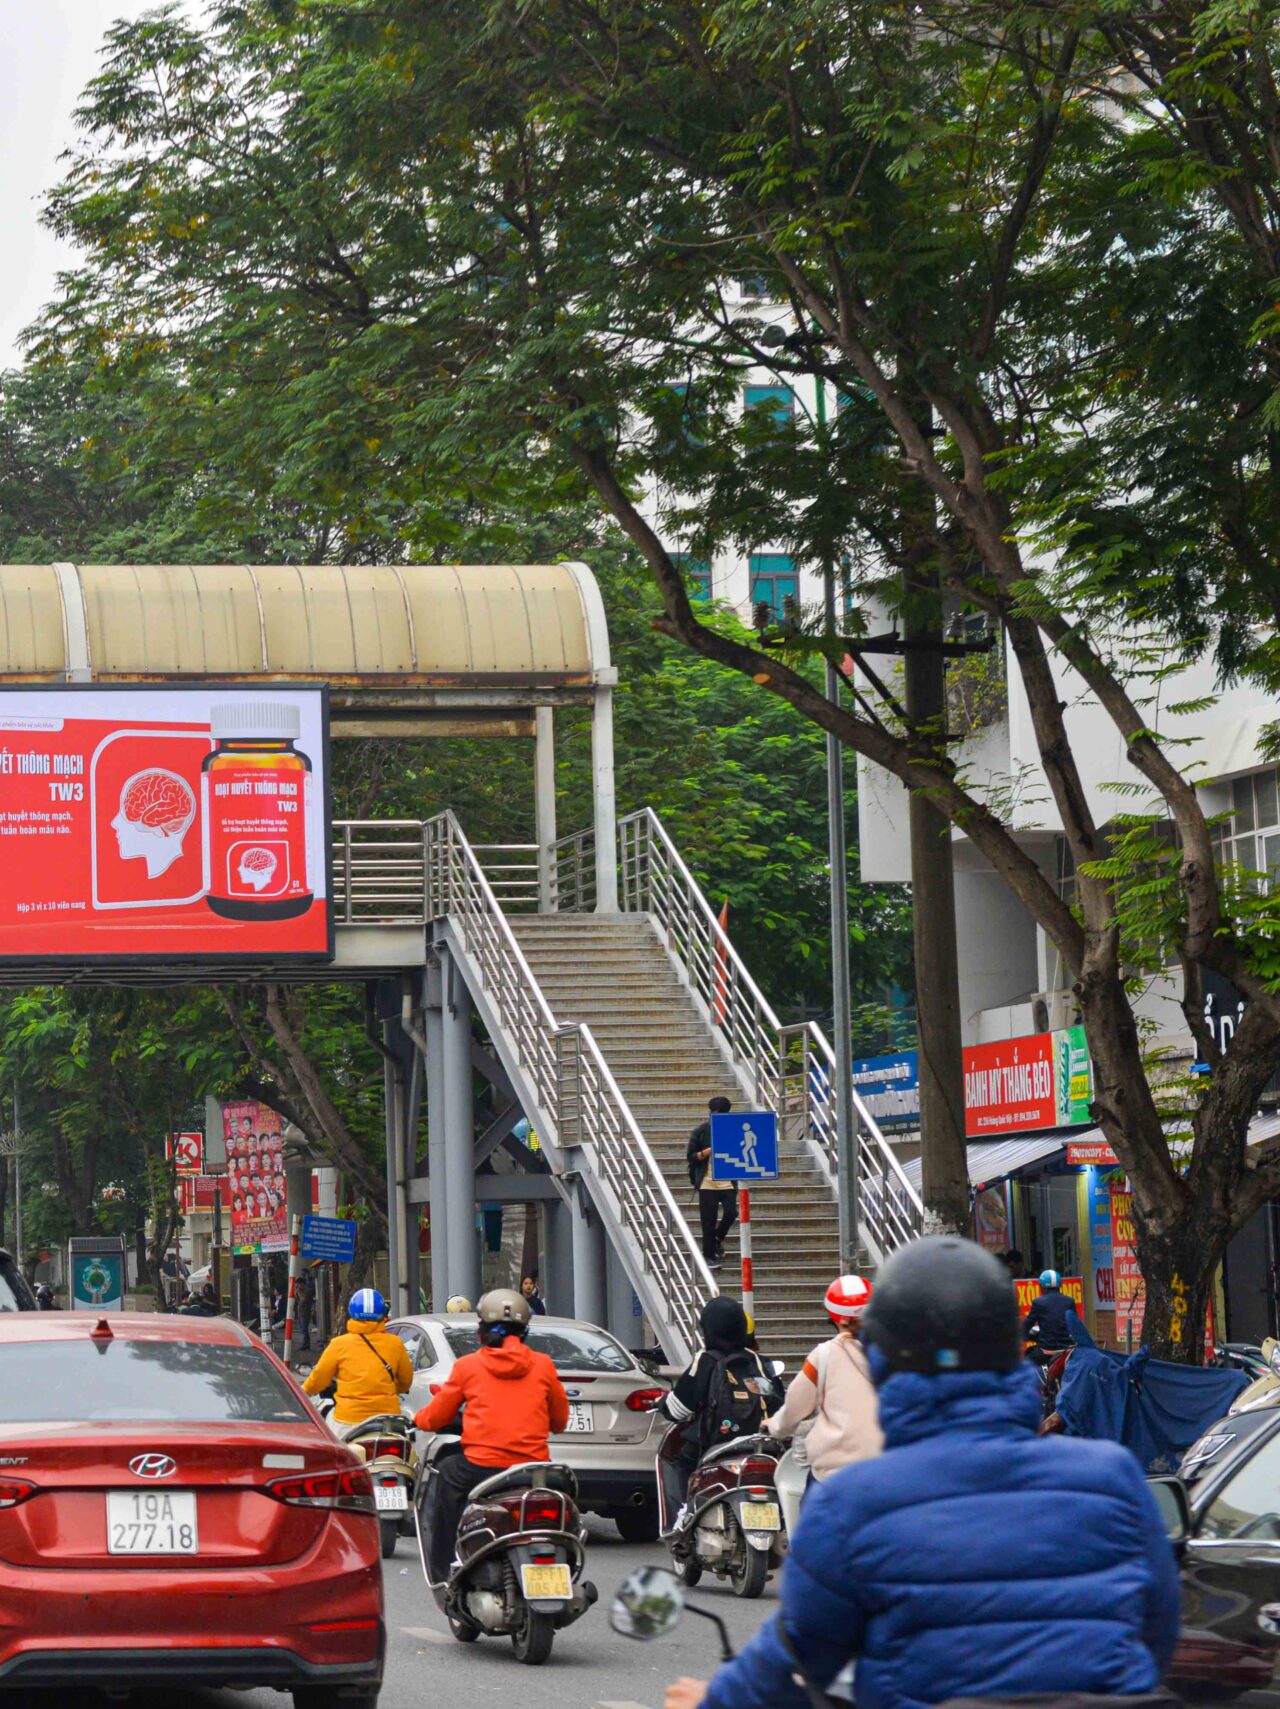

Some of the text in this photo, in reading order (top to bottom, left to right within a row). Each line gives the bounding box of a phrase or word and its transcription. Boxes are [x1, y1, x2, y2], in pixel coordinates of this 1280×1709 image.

[16, 750, 50, 774] THÔNG
[53, 754, 83, 779] MẠCH
[48, 782, 84, 801] TW3
[277, 800, 298, 812] TW3
[30, 811, 50, 822] thông
[19, 825, 37, 834] hoàn
[39, 825, 54, 834] máu
[965, 1061, 988, 1108] BÁNH
[989, 1057, 1002, 1105] MỲ
[1033, 1050, 1051, 1099] BÉO
[568, 1418, 592, 1431] 7.51
[132, 1495, 174, 1521] 19A
[112, 1524, 194, 1549] 277.18
